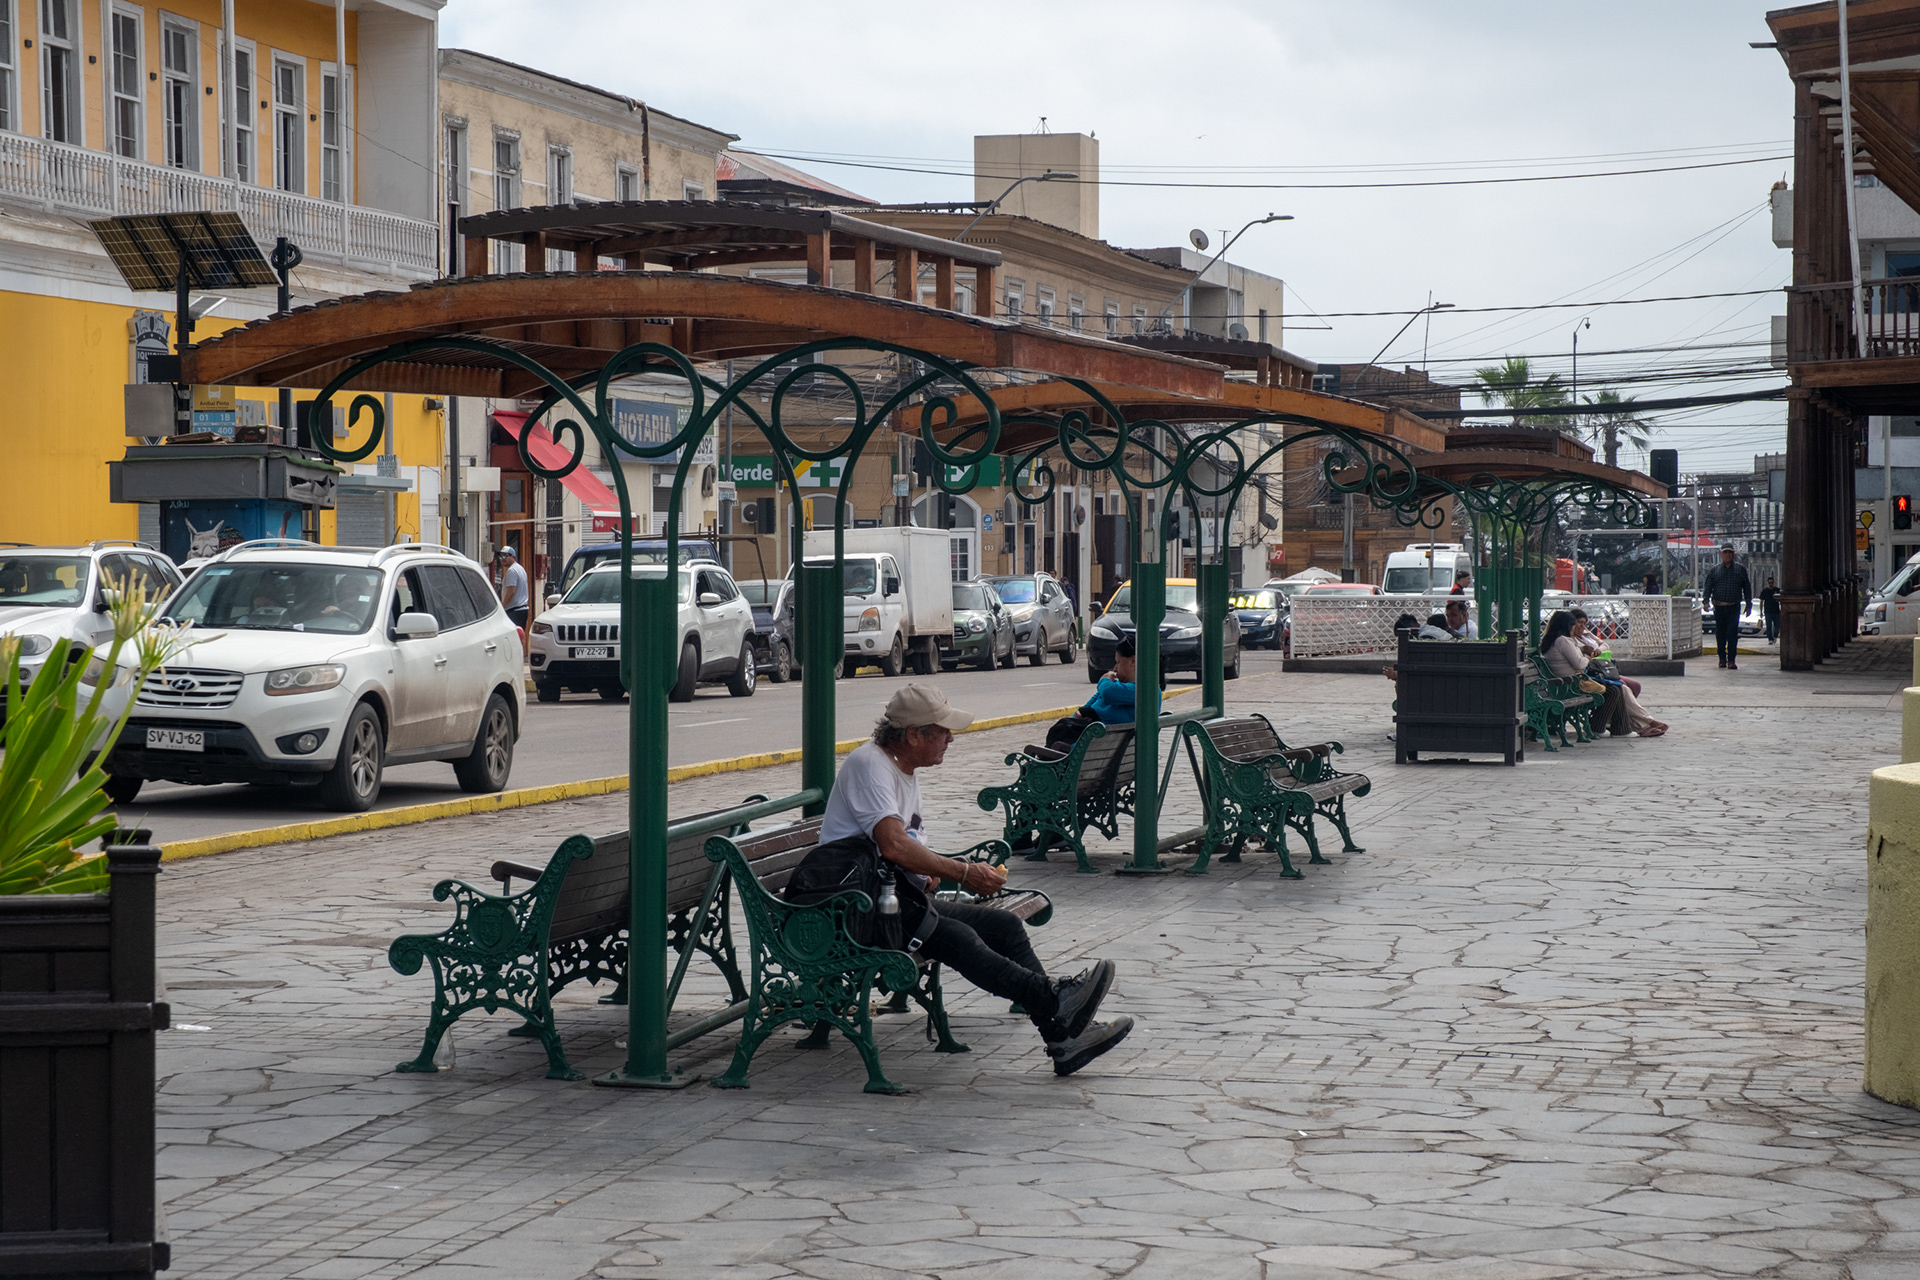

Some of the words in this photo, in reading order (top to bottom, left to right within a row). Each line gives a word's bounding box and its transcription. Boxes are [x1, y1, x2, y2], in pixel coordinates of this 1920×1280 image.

[199, 413, 209, 421] 01
[618, 411, 673, 443] NOTARIA
[722, 464, 773, 481] Verde
